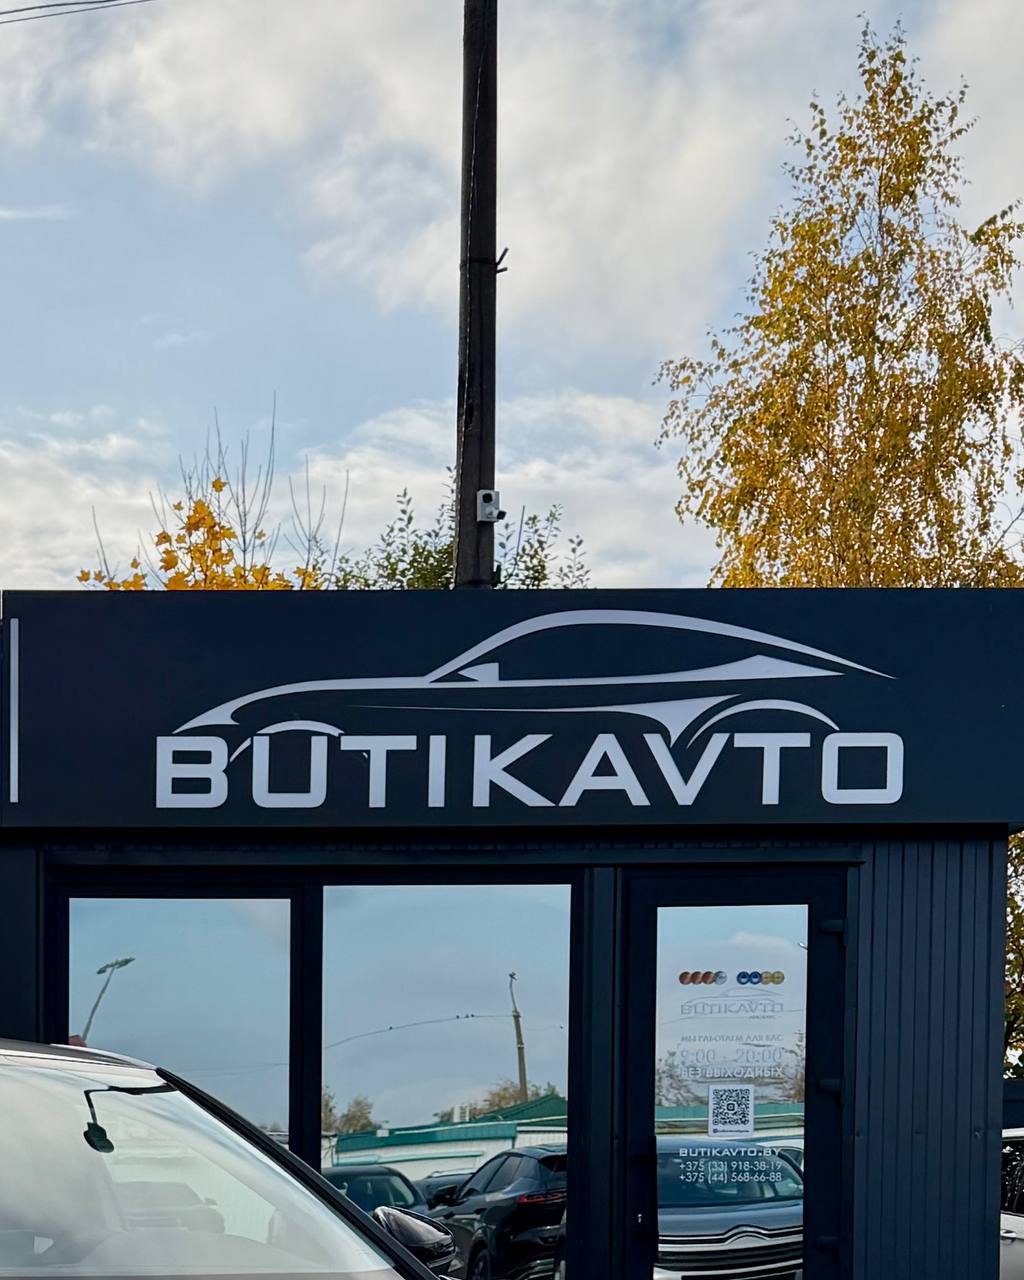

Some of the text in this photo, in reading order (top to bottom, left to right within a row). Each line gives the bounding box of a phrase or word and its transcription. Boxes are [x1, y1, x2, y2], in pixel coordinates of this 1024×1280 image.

[155, 731, 905, 809] BUTIKAVTO
[679, 1147, 782, 1157] BUTIKAVTO.BY
[679, 1161, 782, 1174] +375 (33) 918-38-19
[679, 1172, 782, 1184] +375 (44) 568-66-88
